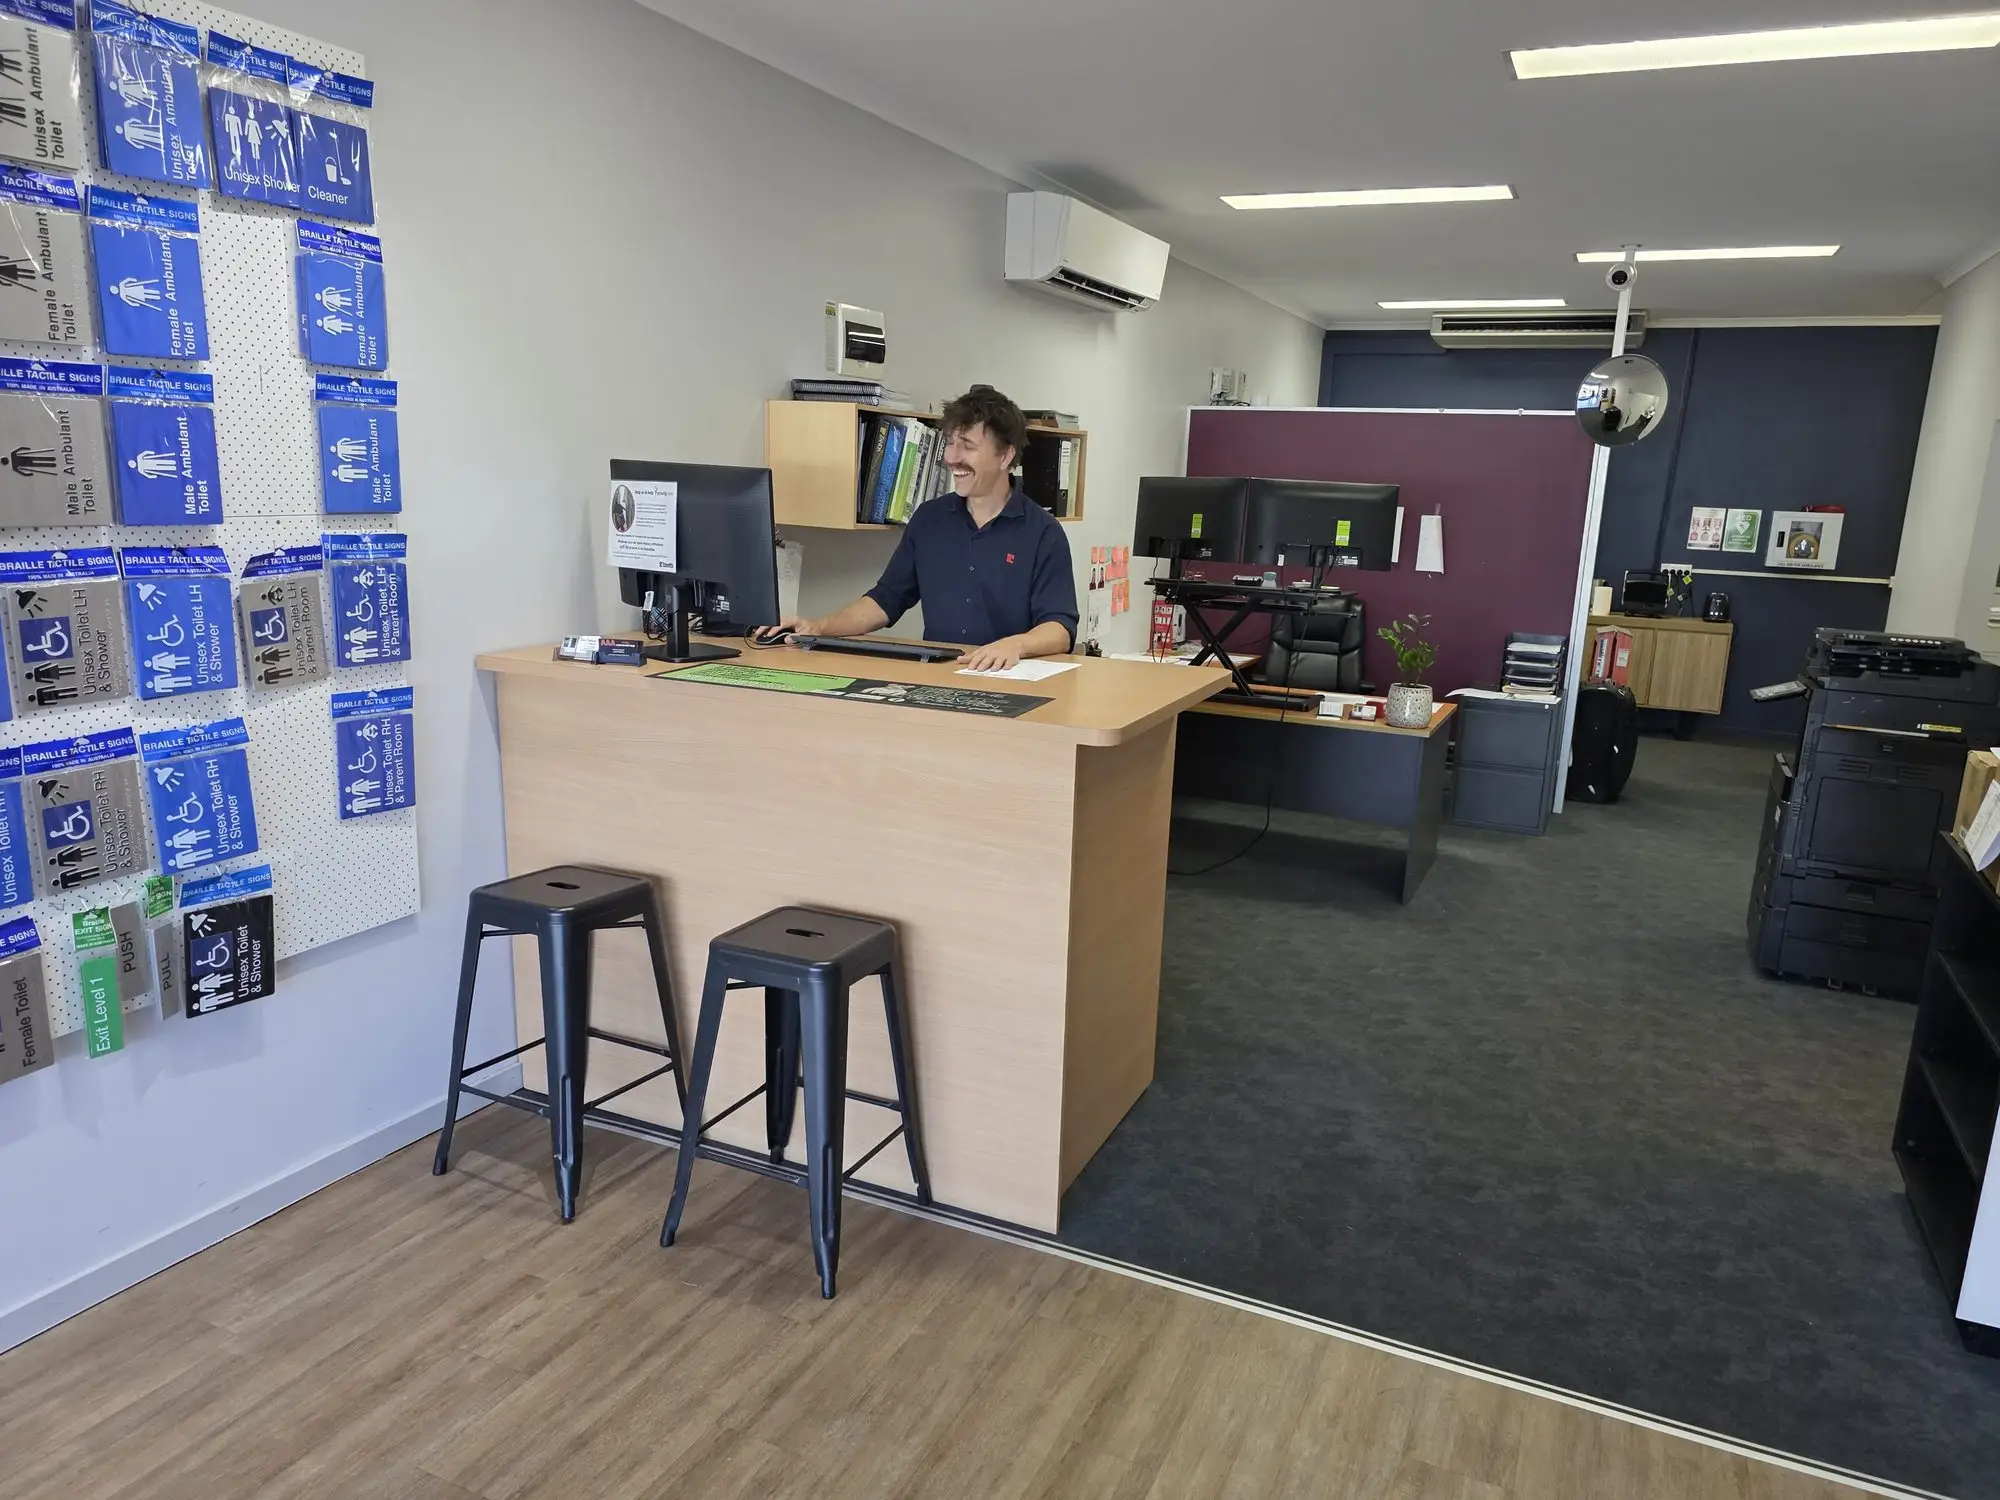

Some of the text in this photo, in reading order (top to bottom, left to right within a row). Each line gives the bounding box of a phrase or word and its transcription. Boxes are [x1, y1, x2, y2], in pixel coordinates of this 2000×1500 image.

[40, 0, 74, 17] SIGNS
[93, 9, 130, 29] BRAILLE
[168, 31, 198, 46] SIGNS
[209, 42, 286, 73] BRAILLE SIG
[25, 27, 49, 159] Unisex Ambulant
[348, 85, 373, 98] SIGNS
[51, 120, 65, 160] Toilet
[167, 133, 184, 180] Unisex
[2, 175, 76, 198] TACTILE SIGNS
[223, 165, 301, 194] Unisex Shower
[307, 184, 349, 205] Cleaner
[92, 195, 129, 211] BRAILLE
[168, 210, 198, 222] SIGNS
[300, 228, 330, 242] BRAILLE
[359, 241, 382, 253] SIGNS
[36, 210, 61, 342] Female Ambulant
[158, 235, 183, 357] Female Ambulant
[353, 262, 367, 367] Female Ambulant
[62, 303, 77, 342] Toilet
[182, 321, 197, 357] Toilet
[367, 336, 378, 366] Toilet
[0, 368, 101, 383] ILLE TACTILE SIGNS
[21, 383, 38, 391] MADE
[47, 385, 76, 393] AUSTRALIA
[109, 376, 213, 392] BRAILLE TACTILE SIGNS
[316, 382, 346, 393] BRAILLE
[374, 388, 396, 396] SIGNS
[57, 409, 80, 515] Male Ambulant
[176, 416, 197, 515] Male Ambulant
[368, 418, 382, 504] Male Ambulant
[81, 477, 97, 515] Toilet
[196, 480, 210, 515] Toilet
[383, 473, 392, 503] Toilet
[0, 561, 44, 571] BRAILLE
[87, 555, 115, 565] SIGNS
[125, 556, 166, 565] BRAILLE
[202, 556, 227, 564] SIGNS
[298, 553, 322, 562] SIGNS
[331, 543, 358, 551] BRAILLE
[384, 542, 406, 550] SIGNS
[286, 581, 307, 677] Unisex Toilet LH
[299, 586, 318, 674] & Parent Room
[376, 567, 392, 657] Unisex Toilet LH
[388, 573, 401, 656] & Parent Room
[72, 588, 97, 696] Unisex Toilet LH
[189, 584, 210, 685] Unisex Toilet LH
[208, 623, 224, 683] & Shower
[95, 629, 112, 692] & Shower
[333, 699, 363, 709] BRAILLE
[391, 694, 413, 703] SIGNS
[24, 736, 134, 763] BRAILLE TACTILE SIGNS
[143, 738, 185, 751] BRAILLE
[221, 725, 246, 738] SIGNS
[0, 757, 20, 768] GNS
[88, 752, 115, 763] AUSTRALIA
[381, 718, 395, 806] Unisex Toilet RH
[393, 723, 405, 803] & Parent Room
[91, 769, 118, 874] Unisex Toilet RH
[205, 758, 230, 855] Unisex Toilet RH
[227, 795, 244, 850] & Shower
[115, 807, 133, 868] & Shower
[1, 855, 18, 903] Unisex
[183, 884, 215, 898] BRAILLE
[247, 873, 271, 885] SIGNS
[8, 928, 36, 944] SIGNS
[75, 927, 93, 936] EXIT
[119, 930, 136, 973] PUSH
[237, 924, 250, 999] Unisex Toilet
[250, 939, 262, 993] & Shower
[159, 951, 173, 991] PULL
[93, 984, 108, 1019] Level
[15, 976, 37, 1068] Female Toilet
[96, 1020, 111, 1052] Exit
